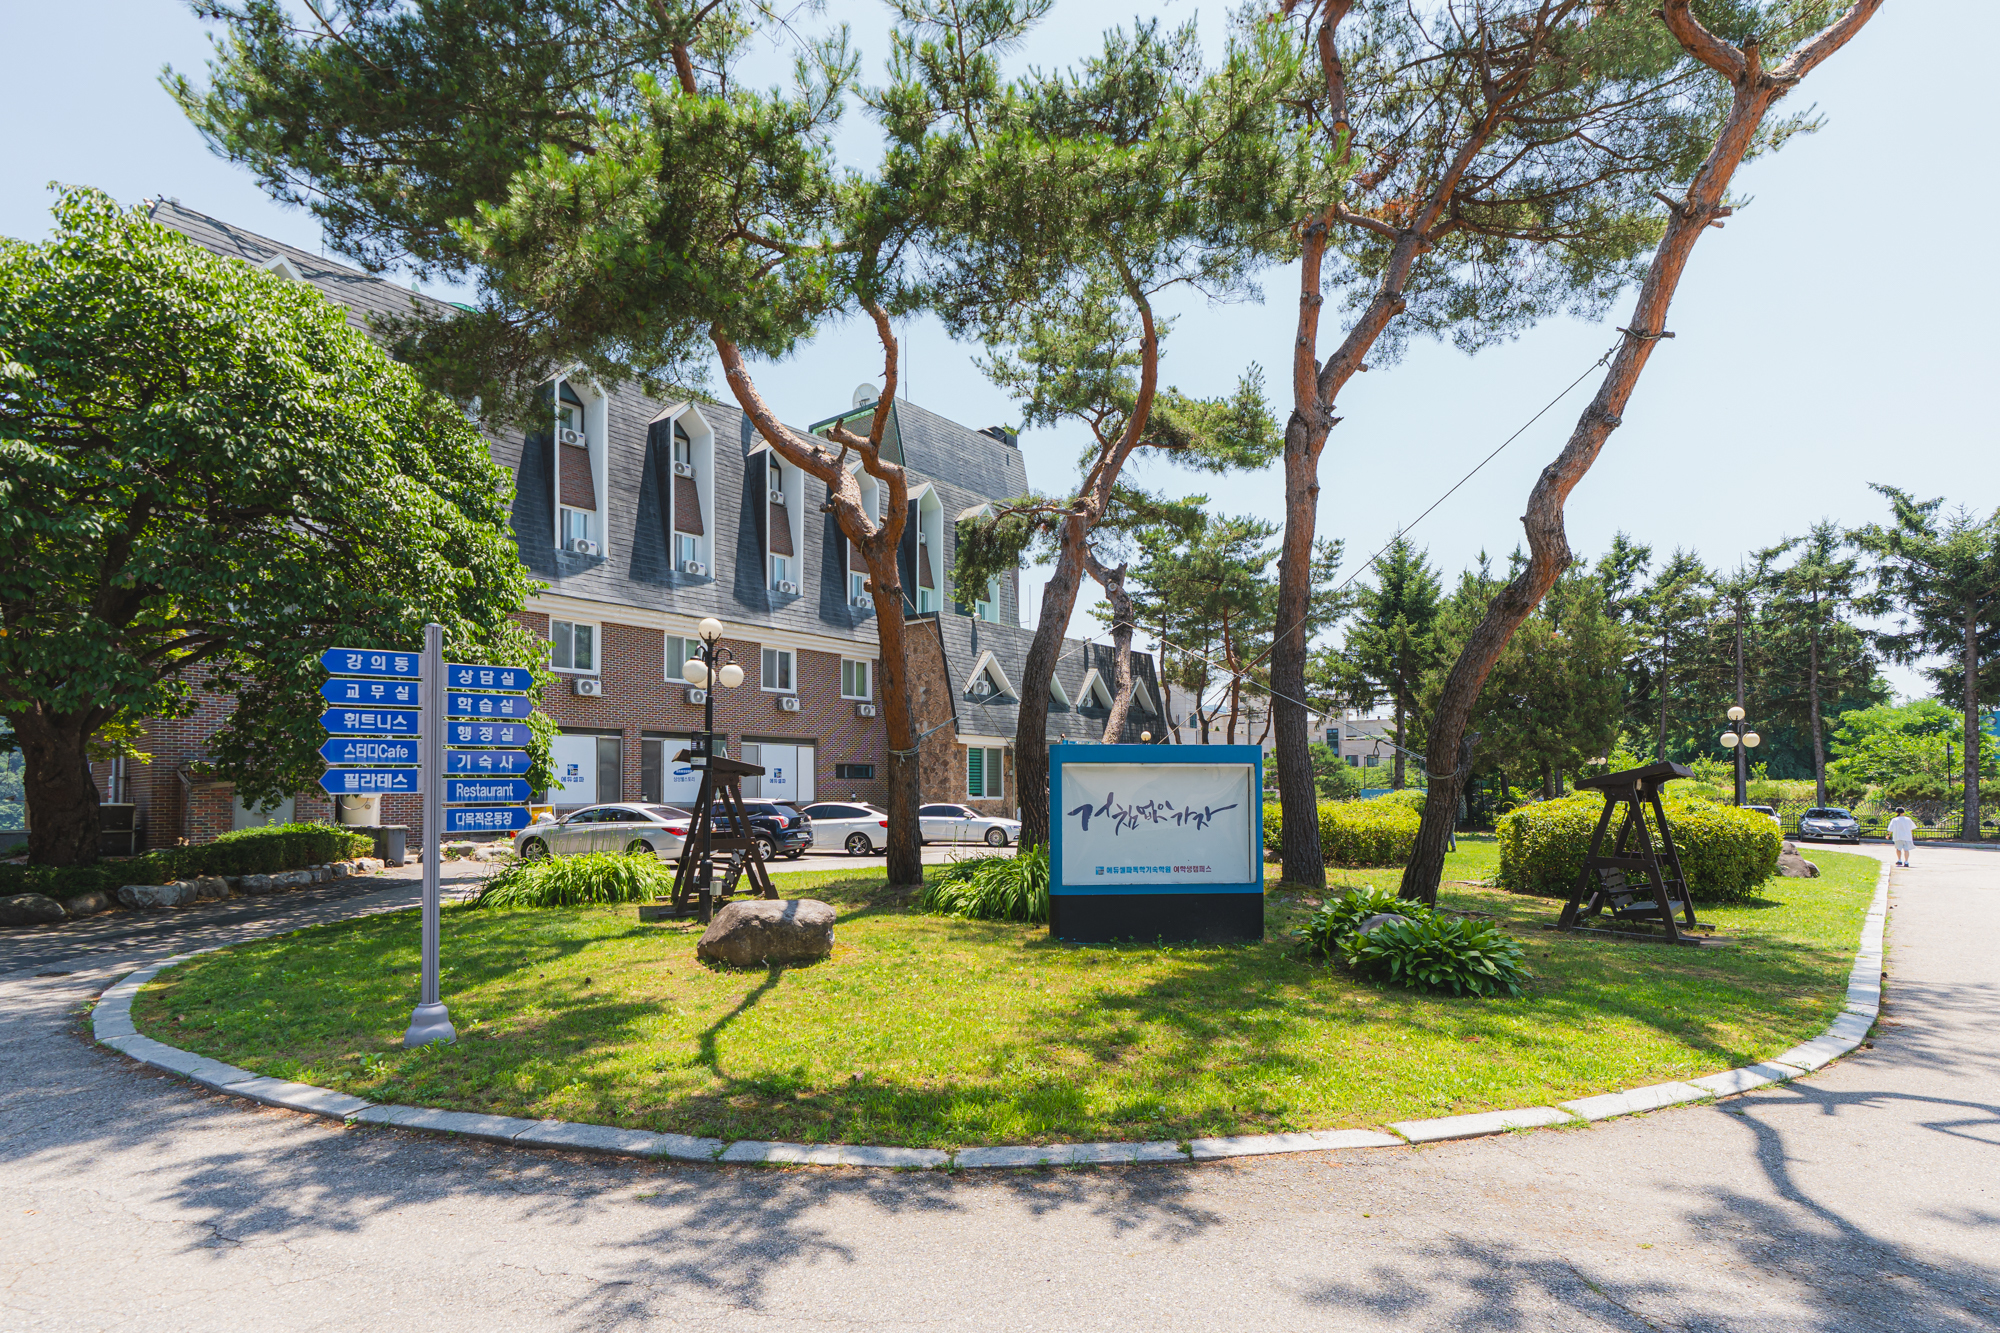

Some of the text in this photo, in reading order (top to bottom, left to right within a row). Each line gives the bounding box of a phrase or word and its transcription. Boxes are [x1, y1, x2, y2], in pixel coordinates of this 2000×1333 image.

[343, 712, 408, 730] 휘트니스
[344, 743, 409, 759] 스터디Cafe
[343, 773, 408, 789] 필라테스
[456, 783, 513, 798] Restaurant
[455, 812, 513, 827] 다목적운동장
[1170, 803, 1239, 831] 가자
